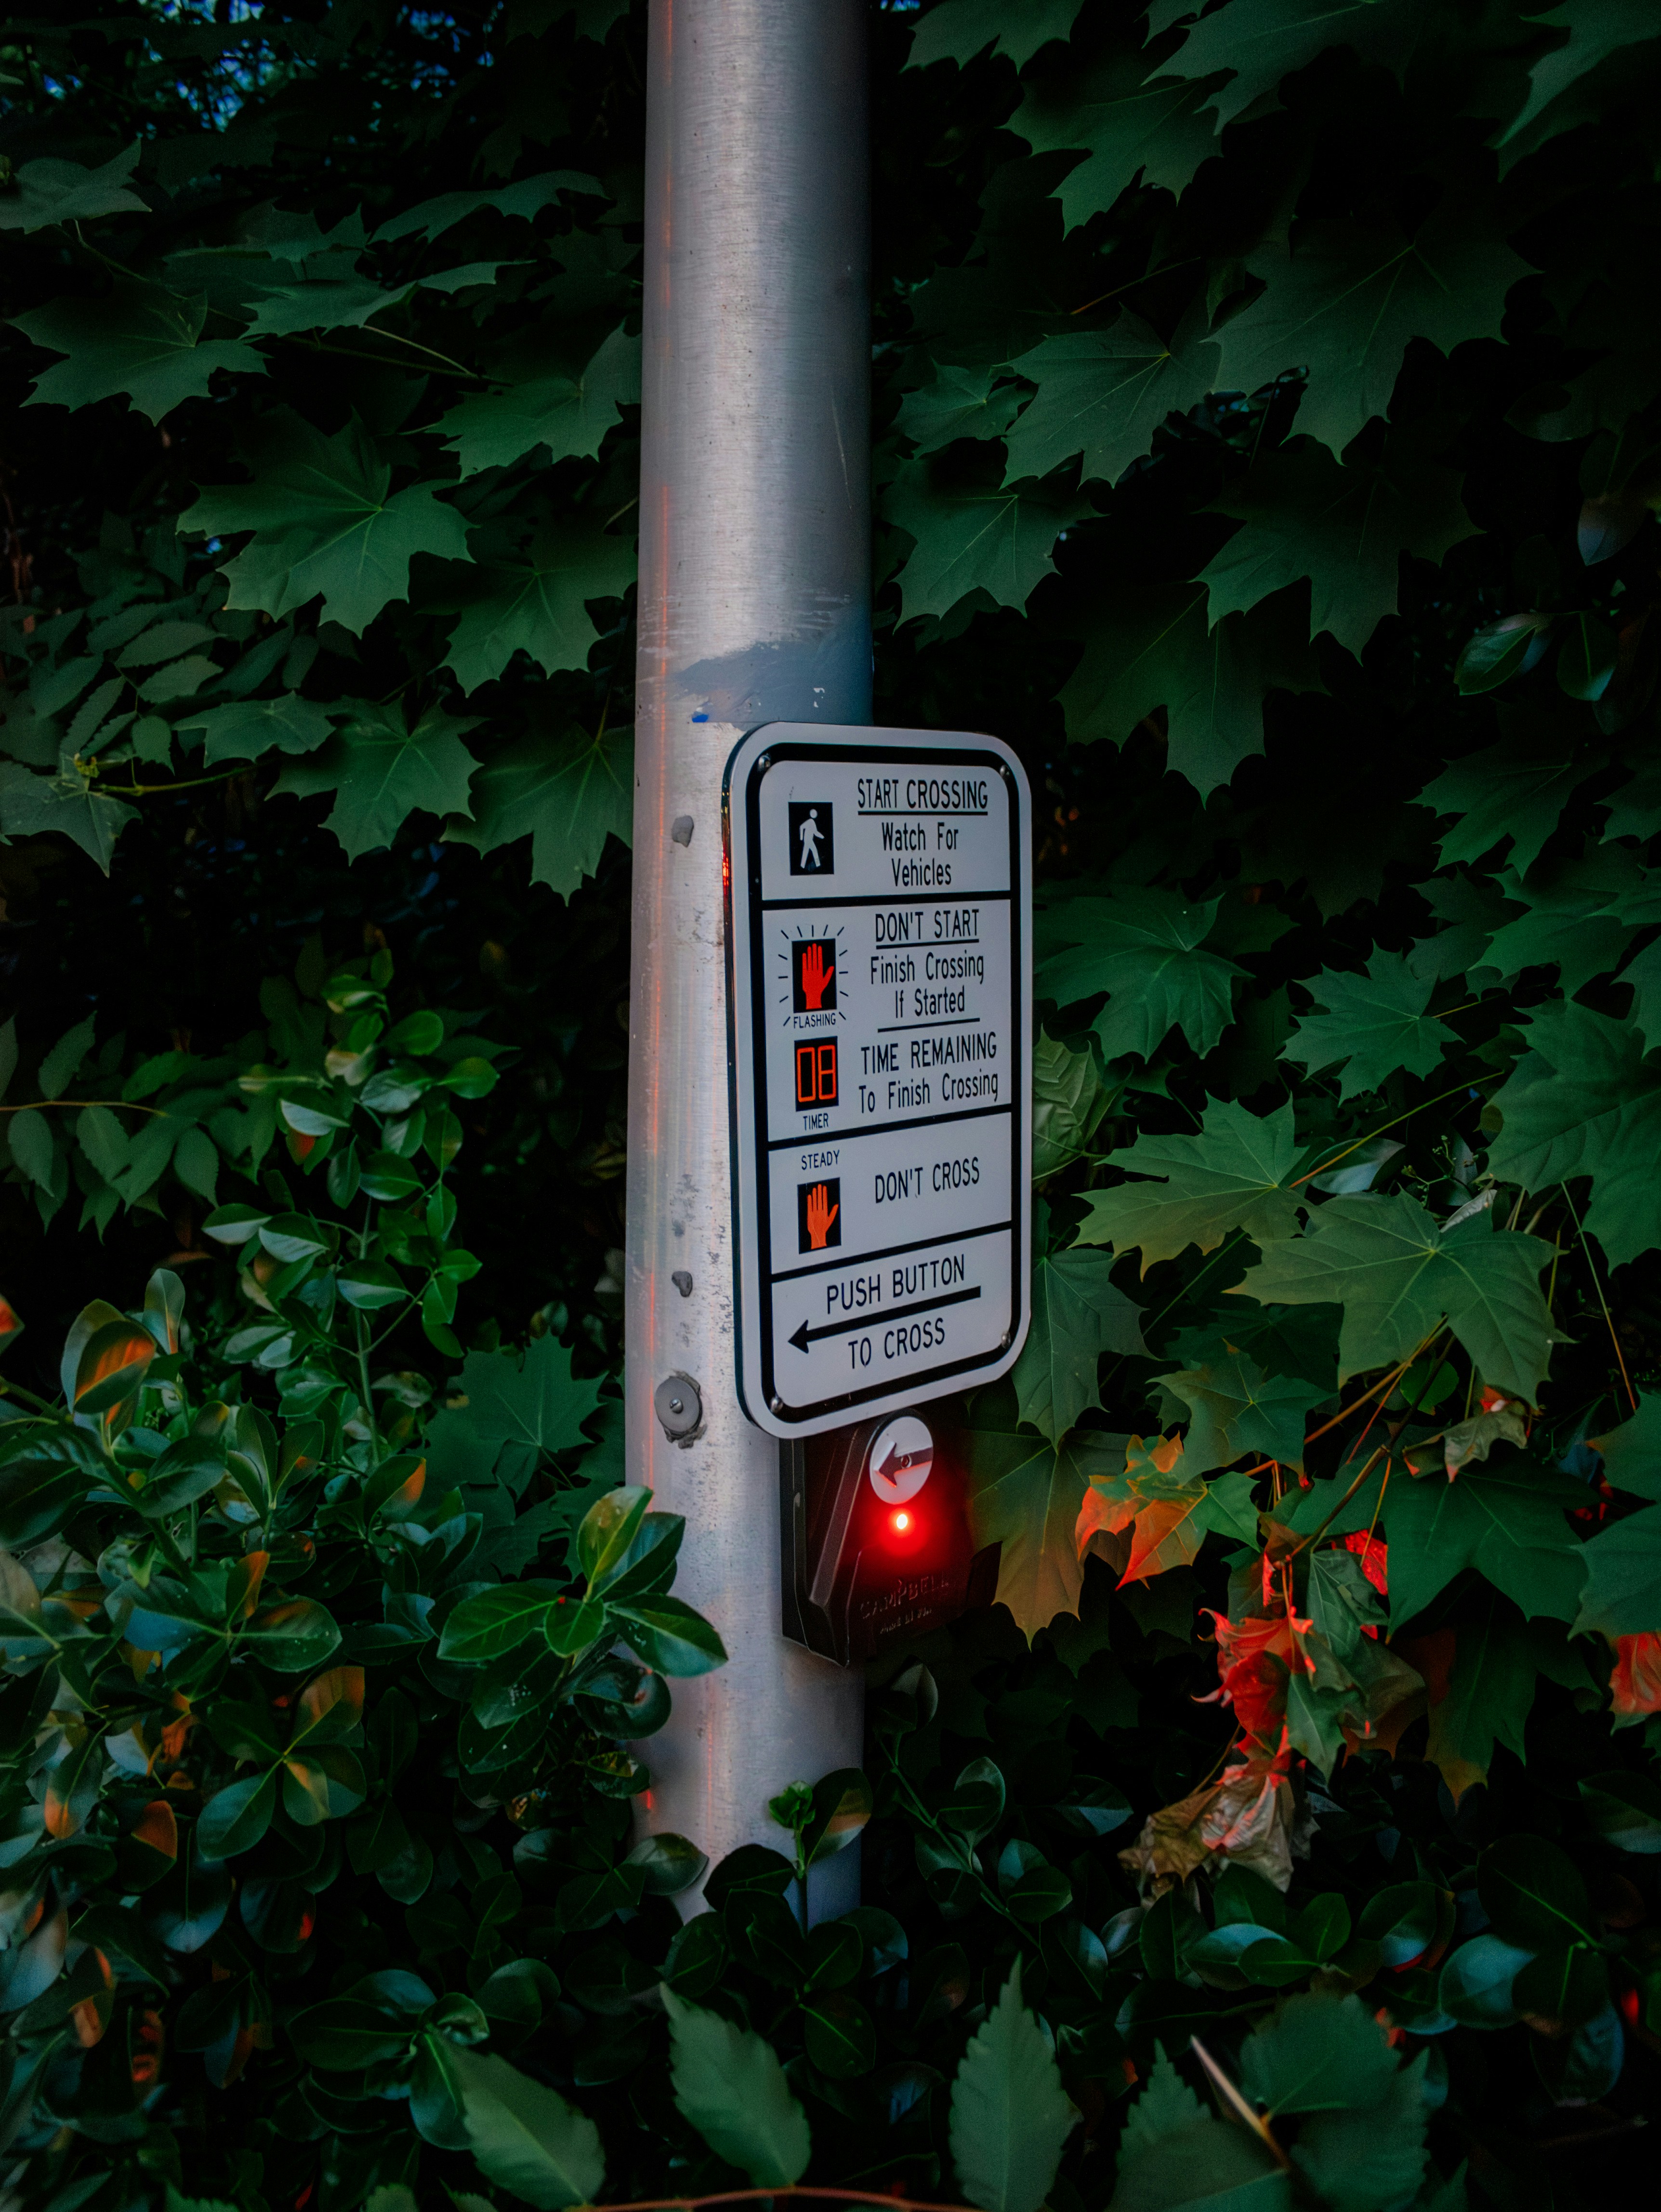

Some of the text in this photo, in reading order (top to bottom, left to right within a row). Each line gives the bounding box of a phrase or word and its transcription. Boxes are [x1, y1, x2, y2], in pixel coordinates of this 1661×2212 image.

[857, 778, 988, 809] START CROSSING
[881, 822, 959, 852] Watch For
[891, 857, 952, 887] Vehicles
[875, 908, 980, 942] DON'T START
[870, 949, 984, 985] Finish Crossing
[895, 984, 965, 1019] If Started
[793, 1013, 836, 1029] FLASHING
[860, 1031, 997, 1075] TIME REMAINING
[797, 1045, 836, 1103] 08
[858, 1068, 999, 1114] To Finish Crossing
[803, 1113, 829, 1131] TIMER
[801, 1149, 840, 1171] STEADY
[875, 1157, 980, 1203] DON'T CROSS
[827, 1254, 964, 1315] PUSH BUTTON
[848, 1318, 945, 1369] TO CROSS
